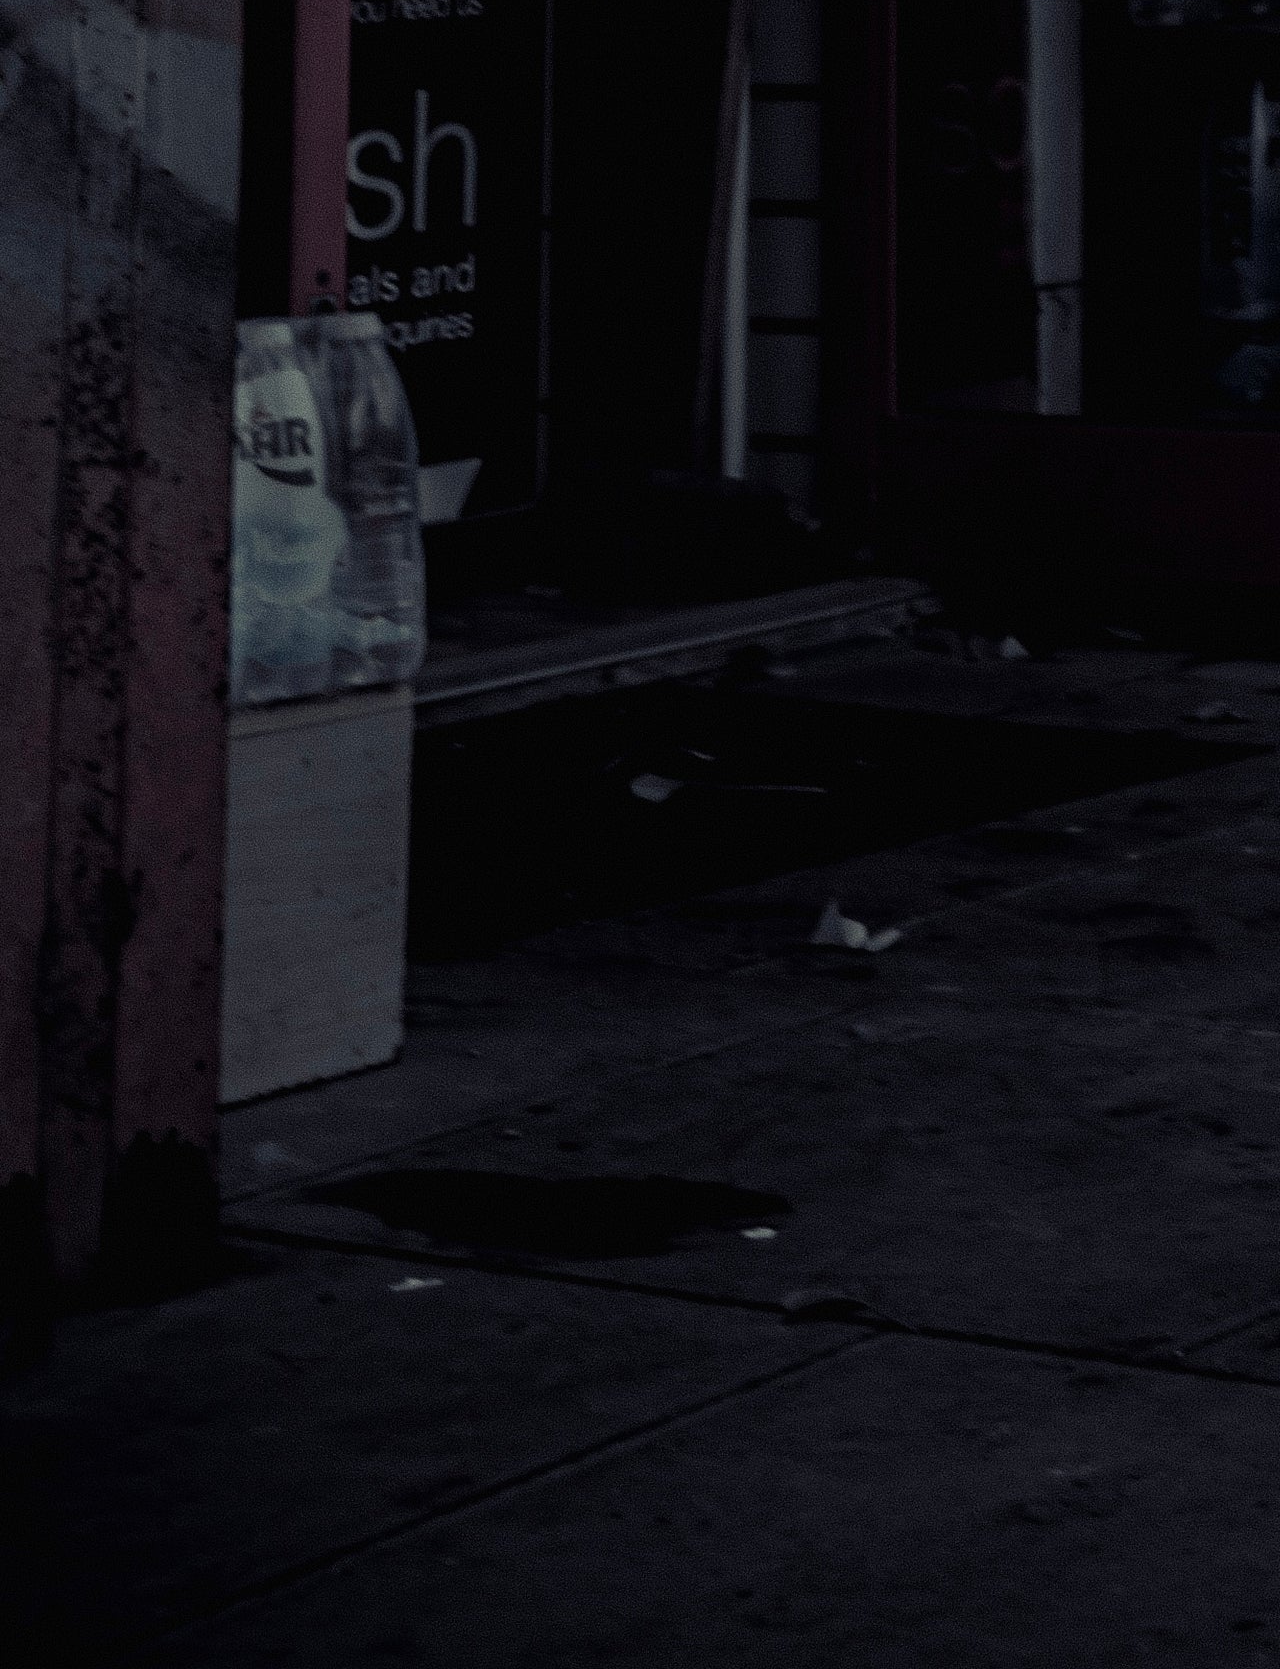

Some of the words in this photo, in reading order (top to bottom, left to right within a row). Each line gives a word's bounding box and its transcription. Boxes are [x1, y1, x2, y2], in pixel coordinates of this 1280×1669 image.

[351, 0, 387, 24] ou
[346, 87, 478, 242] sh
[347, 263, 400, 306] als
[409, 251, 477, 298] and
